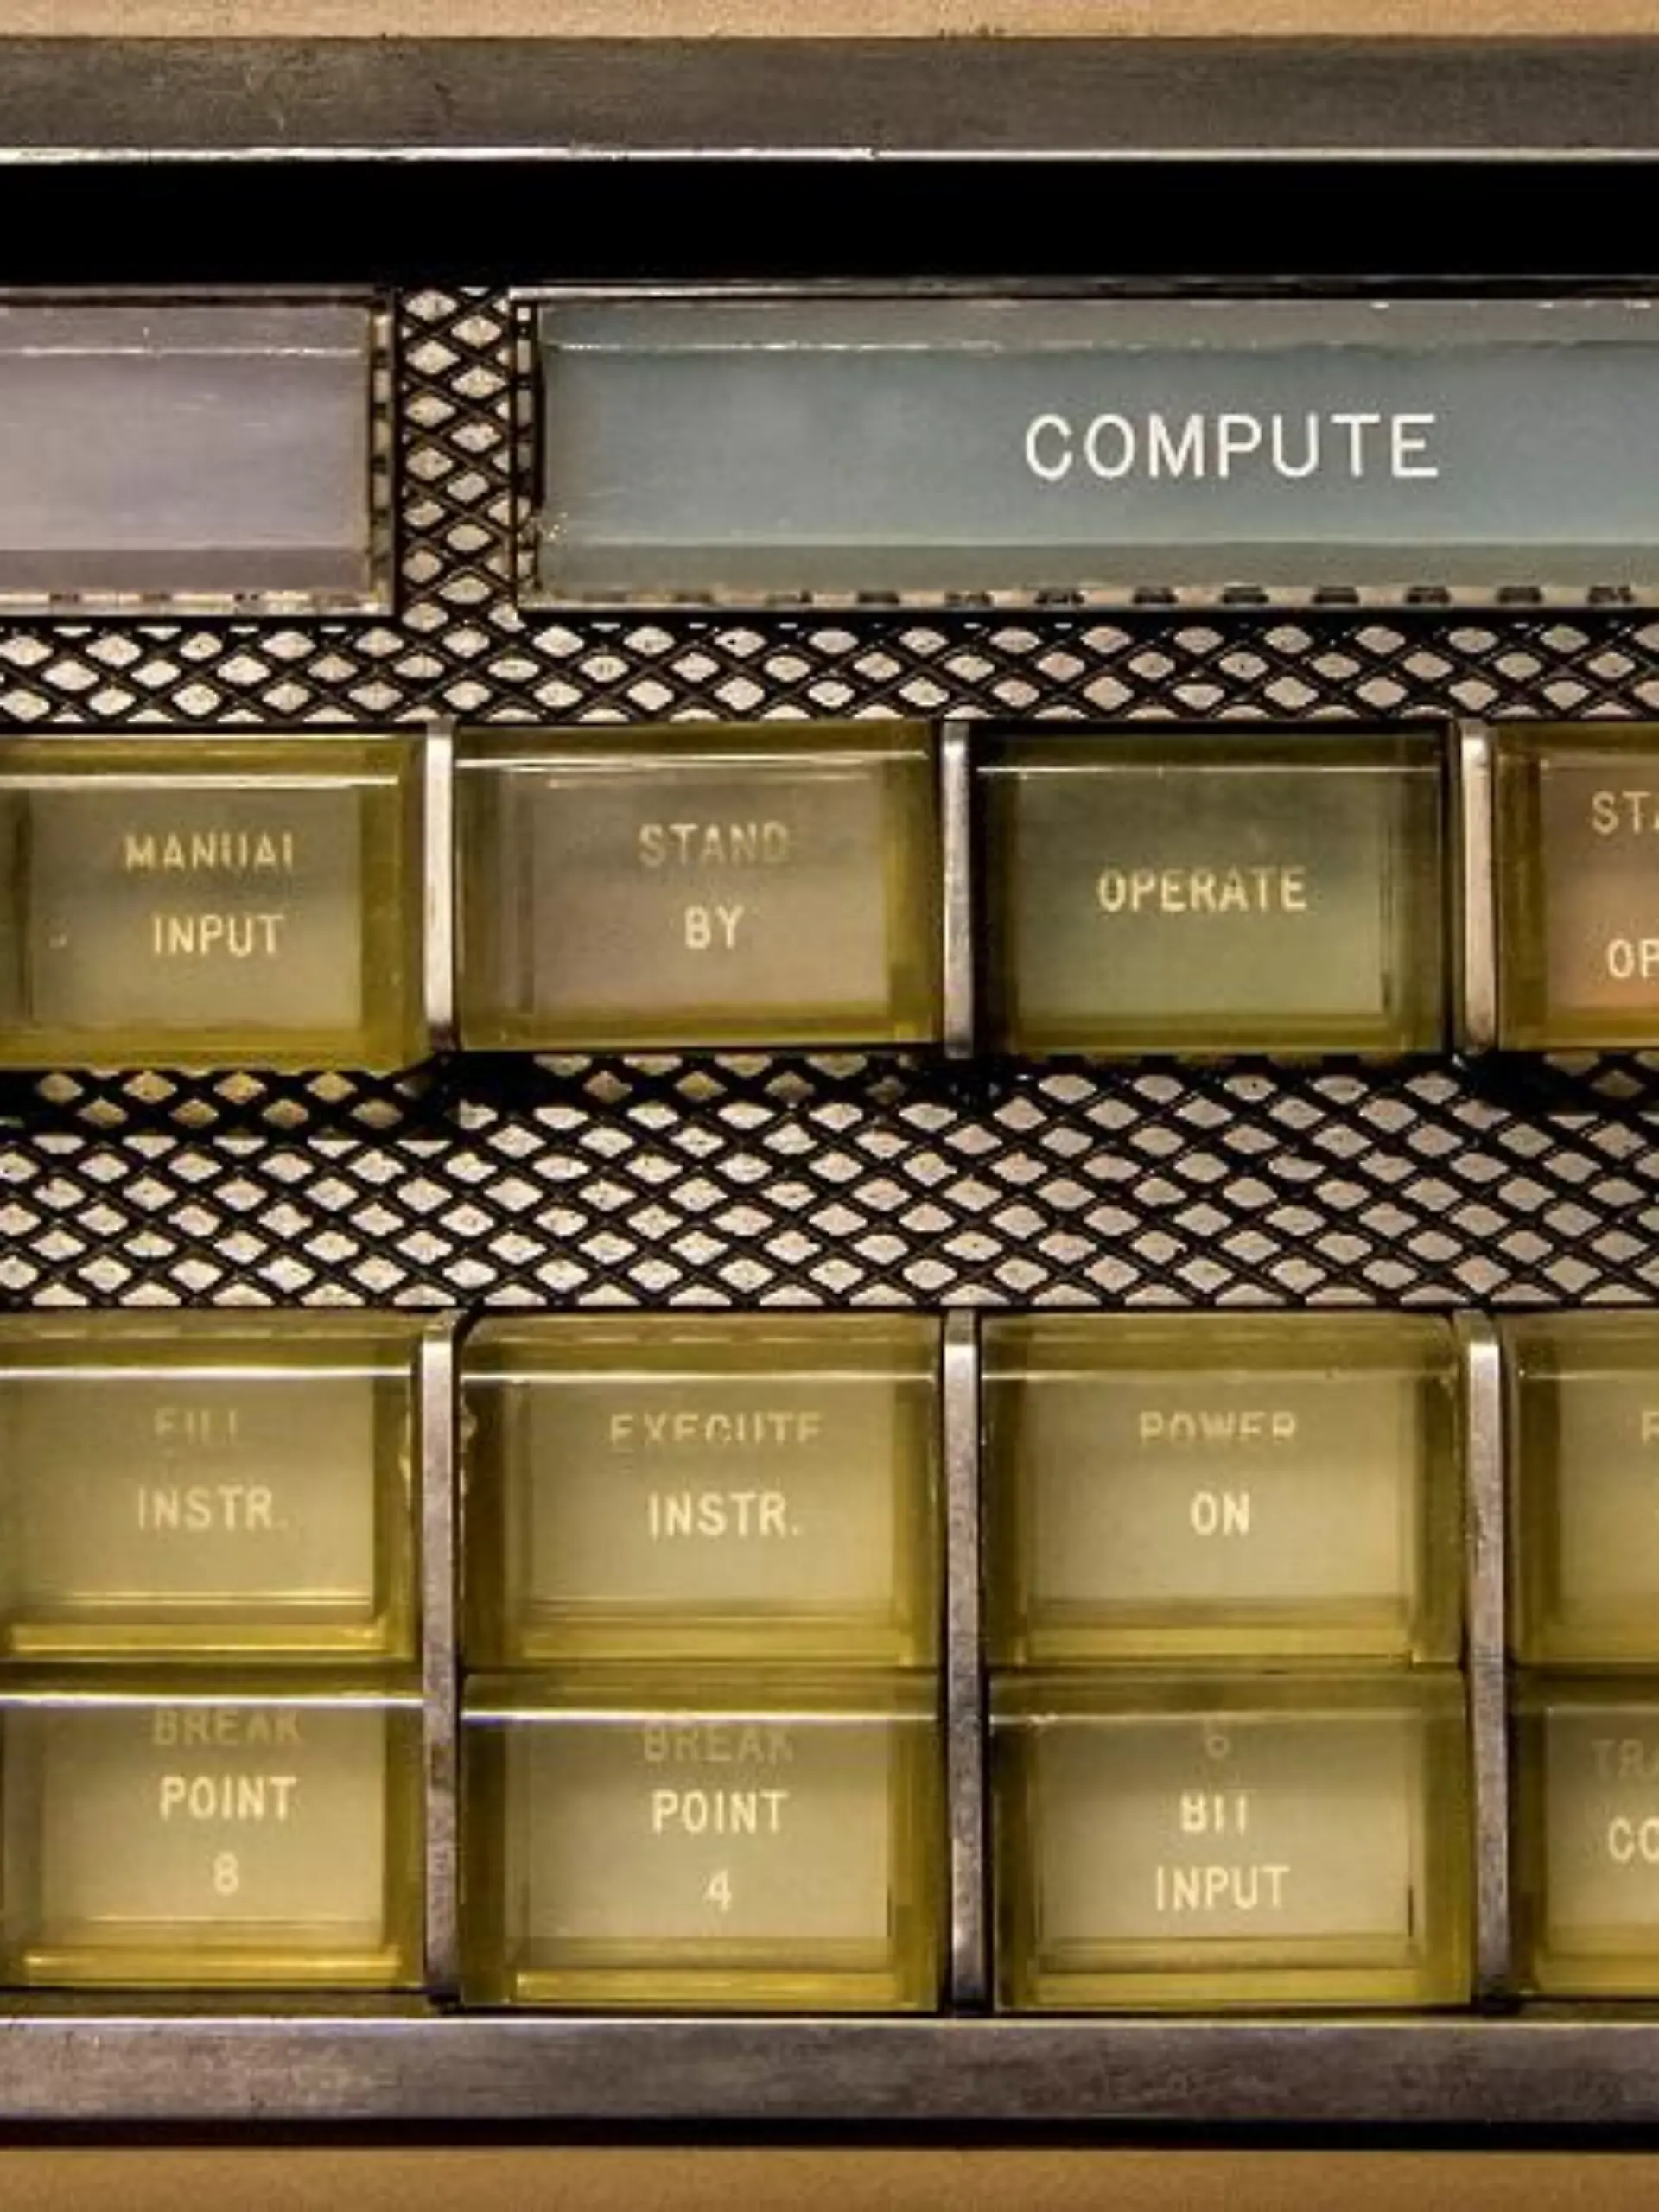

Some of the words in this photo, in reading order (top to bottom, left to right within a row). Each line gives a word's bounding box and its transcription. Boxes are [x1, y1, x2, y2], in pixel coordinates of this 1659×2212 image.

[1025, 413, 1439, 479] COMPUTE
[639, 821, 790, 866] STAND
[1098, 866, 1307, 912] OPERATE
[152, 912, 284, 957] INPUT
[684, 905, 745, 950] BY
[138, 1484, 289, 1530] INSTR.
[649, 1489, 802, 1538] INSTR.
[1190, 1491, 1250, 1536] ON
[153, 1706, 302, 1747] BREAK
[159, 1775, 297, 1821] POINT
[652, 1789, 790, 1834] POINT
[213, 1851, 239, 1895] 8
[702, 1870, 732, 1911] 4
[1156, 1863, 1290, 1910] INPUT
